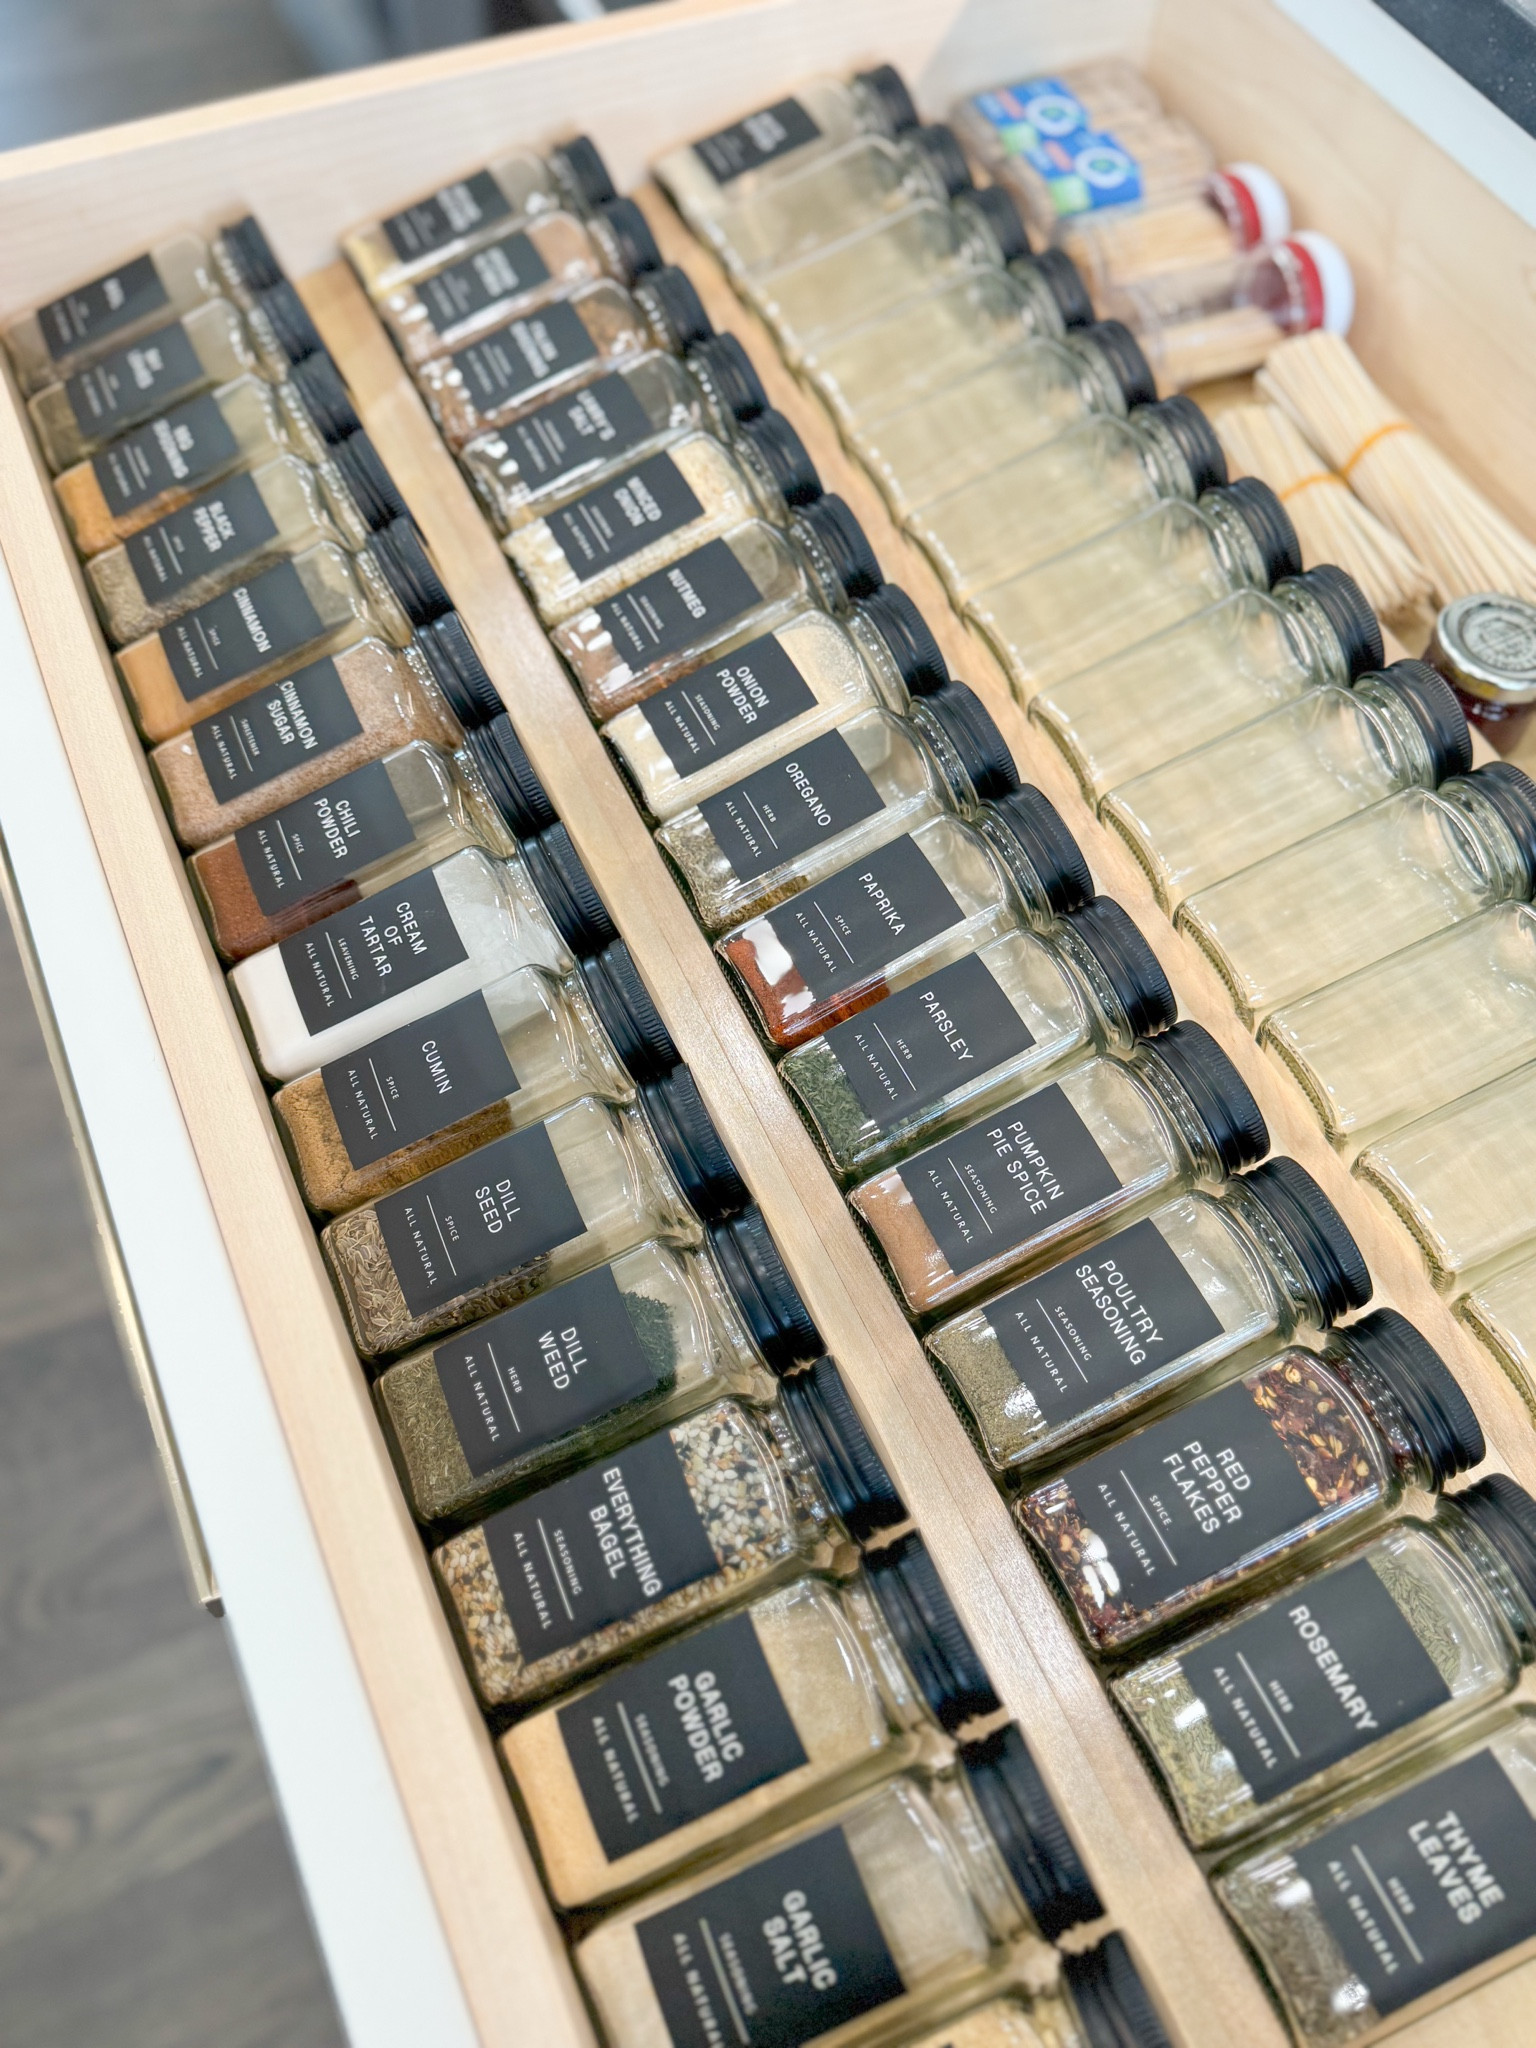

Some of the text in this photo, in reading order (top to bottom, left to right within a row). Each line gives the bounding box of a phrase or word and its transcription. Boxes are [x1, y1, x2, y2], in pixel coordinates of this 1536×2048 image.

[568, 405, 595, 436] SALT
[208, 501, 235, 540] BLACK
[614, 488, 645, 526] ONION
[627, 476, 662, 521] MINCED
[194, 507, 222, 552] PEPPER
[233, 587, 272, 653] CINNAMON
[668, 568, 706, 619] NUTMEG
[177, 627, 203, 678] ALL NATURAL
[208, 628, 221, 646] SPICE
[611, 603, 645, 652] ALL NATURAL
[280, 681, 318, 749] CINNAMON
[695, 694, 720, 730] SEASONING
[716, 669, 757, 724] POWDER
[736, 666, 769, 708] ONION
[240, 719, 260, 756] SWEETENER
[267, 699, 295, 744] SUGAR
[664, 700, 699, 754] ALL NATURAL
[211, 725, 237, 780] ALL NATURAL
[335, 800, 361, 838] CHILI
[762, 804, 776, 823] HERB
[786, 763, 831, 826] OREGANO
[291, 833, 304, 853] SPICE
[314, 798, 348, 859] POWDER
[725, 802, 762, 858] ALL NATURAL
[258, 830, 285, 889] ALL NATURAL
[396, 902, 427, 955] CREAM
[835, 915, 851, 936] SPICE
[859, 873, 905, 936] PAPRIKA
[338, 938, 359, 981] LEAVENING
[359, 915, 393, 977] TARTAR
[384, 926, 403, 946] OF
[795, 912, 836, 973] ALL NATURAL
[305, 943, 335, 1007] ALL NATURAL
[896, 1039, 912, 1059] HERB
[919, 991, 973, 1061] PARSLEY
[386, 1076, 399, 1100] SPICE
[422, 1040, 452, 1094] CUMIN
[854, 1034, 898, 1101] ALL NATURAL
[348, 1069, 378, 1140] ALL NATURAL
[964, 1164, 997, 1214] SEASONING
[987, 1128, 1047, 1214] PIE SPICE
[1007, 1121, 1064, 1200] PUMPKIN
[445, 1216, 459, 1242] SPICE
[475, 1186, 503, 1234] SEED
[496, 1179, 521, 1222] DILL
[928, 1170, 974, 1243] ALL NATURAL
[404, 1207, 437, 1285] ALL NATURAL
[1076, 1265, 1146, 1365] SEASONING
[1099, 1260, 1164, 1345] POULTRY
[539, 1331, 569, 1390] WEED
[560, 1327, 587, 1375] DILL
[1015, 1311, 1068, 1393] ALL NATURAL
[1055, 1306, 1092, 1361] SEASONING
[464, 1355, 500, 1442] ALL NATURAL
[508, 1367, 522, 1393] HERB
[1163, 1453, 1220, 1534] FLAKES
[1183, 1441, 1242, 1523] PEPPER
[1216, 1448, 1251, 1491] RED
[602, 1467, 662, 1597] EVERYTHING
[1097, 1483, 1155, 1577] ALL NATURAL
[1149, 1495, 1172, 1526] SPICE
[554, 1529, 582, 1593] SEASONING
[590, 1505, 625, 1578] BAGEL
[514, 1533, 553, 1630] ALL NATURAL
[1269, 1680, 1293, 1713] HERB
[1289, 1605, 1378, 1730] ROSEMARY
[668, 1674, 724, 1782] POWDER
[694, 1670, 744, 1762] GARLIC
[1213, 1667, 1278, 1770] ALL NATURAL
[593, 1716, 640, 1823] ALL NATURAL
[634, 1714, 669, 1787] SEASONING
[1408, 1820, 1482, 1924] LEAVES
[1437, 1811, 1505, 1908] THYME
[782, 1890, 837, 1990] GARLIC
[1328, 1861, 1400, 1975] ALL NATURAL
[673, 1933, 693, 1967] ALL
[763, 1915, 807, 1984] SALT
